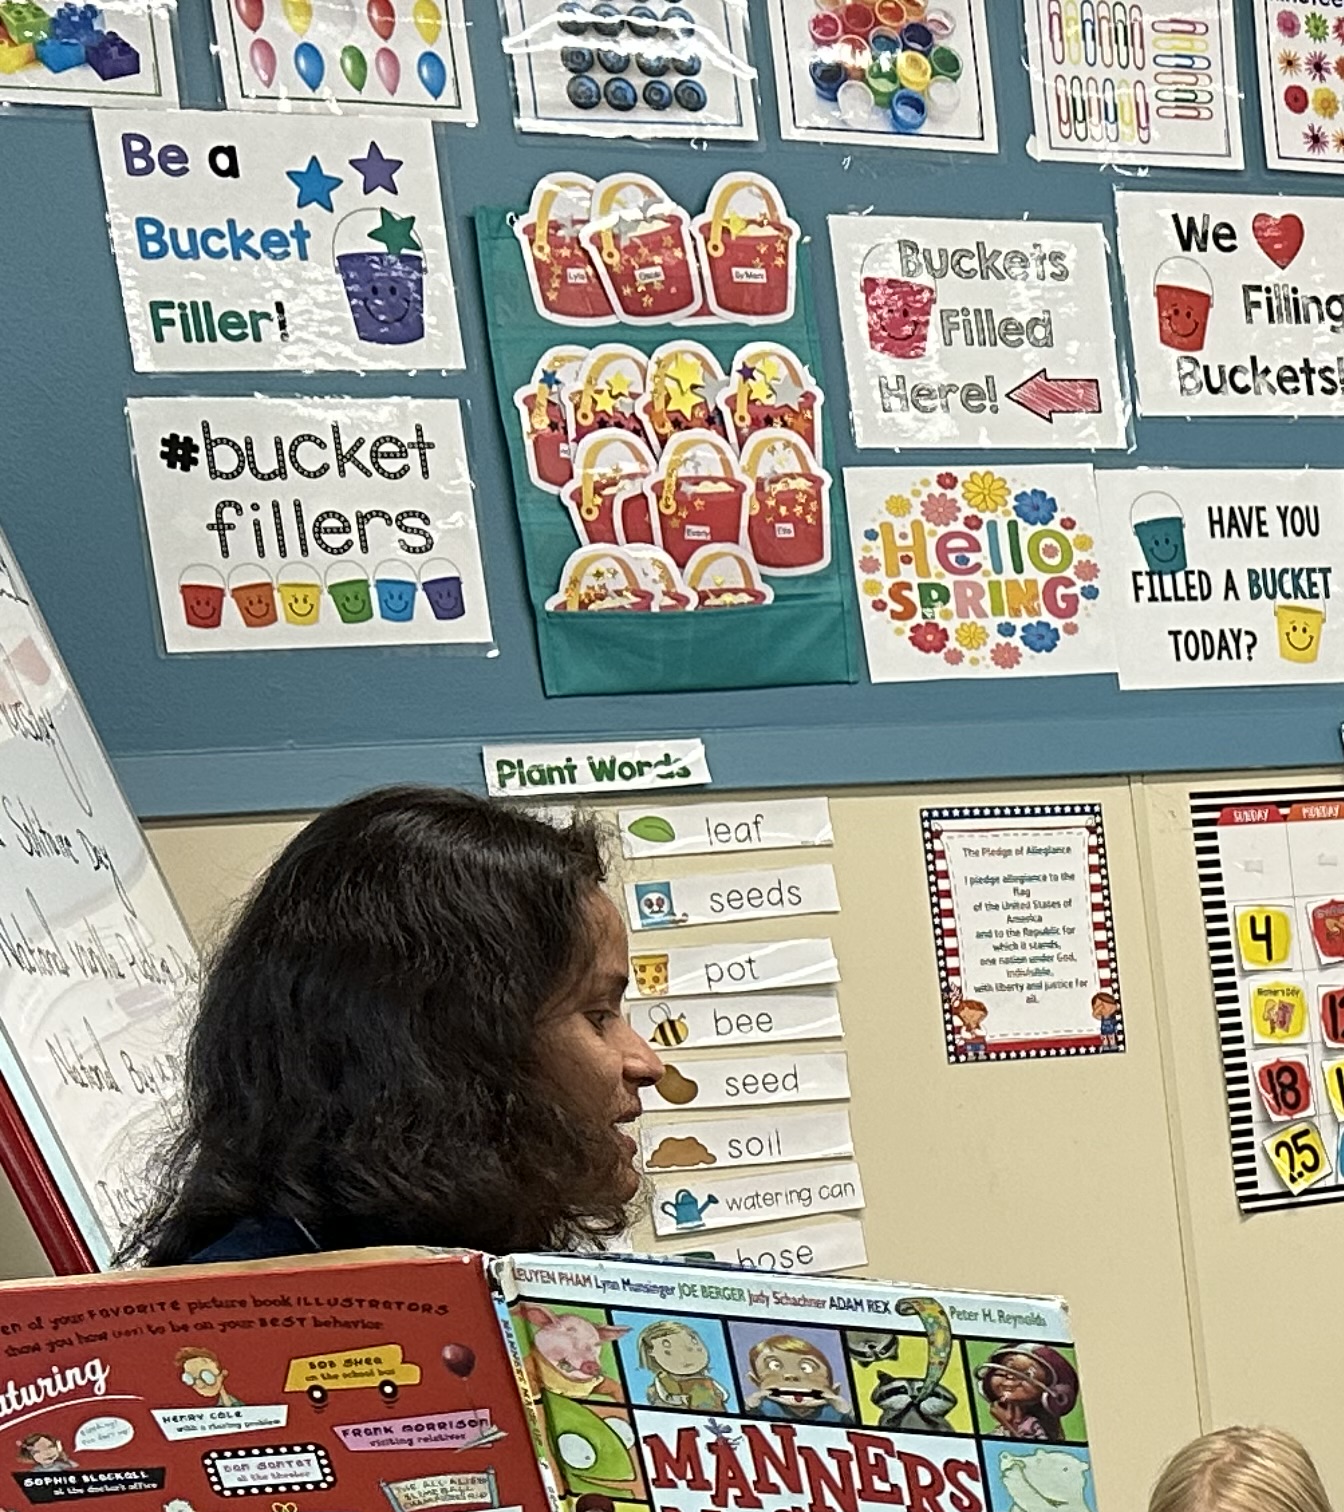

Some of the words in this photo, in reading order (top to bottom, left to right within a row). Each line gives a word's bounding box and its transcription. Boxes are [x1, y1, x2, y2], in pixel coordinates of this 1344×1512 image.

[122, 133, 189, 178] Be
[209, 142, 241, 178] a
[136, 216, 311, 262] Bucket
[1172, 213, 1238, 255] We
[896, 239, 1070, 285] Buckets
[149, 301, 290, 346] Filler!
[940, 307, 1054, 350] Filled
[878, 374, 999, 415] Here!
[160, 420, 435, 484] #bucket
[207, 498, 434, 561] fillers
[1208, 506, 1269, 541] HAVE
[1277, 505, 1322, 538] YOU
[879, 520, 1073, 580] Hello
[888, 576, 1080, 622] SPRING
[1132, 571, 1212, 604] FILLED
[1222, 571, 1239, 602] A
[1248, 568, 1332, 602] BUCKET
[1167, 629, 1257, 663] TODAY?
[496, 757, 577, 787] Plant
[586, 755, 692, 781] Words
[706, 813, 764, 845] leaf
[709, 882, 802, 910] seeds
[1249, 913, 1273, 962] 4
[705, 956, 761, 990] pot
[713, 1008, 774, 1035] bee
[724, 1062, 800, 1096] seed
[1265, 1063, 1300, 1112] 18
[727, 1131, 781, 1158] soil
[1274, 1131, 1322, 1184] 25
[725, 1180, 813, 1213] watering
[818, 1178, 855, 1201] can
[736, 1243, 814, 1270] hose
[512, 1267, 556, 1284] LEUYEN
[558, 1271, 593, 1288] PHAM
[677, 1282, 699, 1298] JOE
[700, 1285, 746, 1302] BERGER
[828, 1296, 865, 1312] ADAM
[867, 1299, 891, 1314] REX
[949, 1305, 980, 1322] Peter
[982, 1308, 996, 1324] H.
[998, 1309, 1048, 1330] Reynolds
